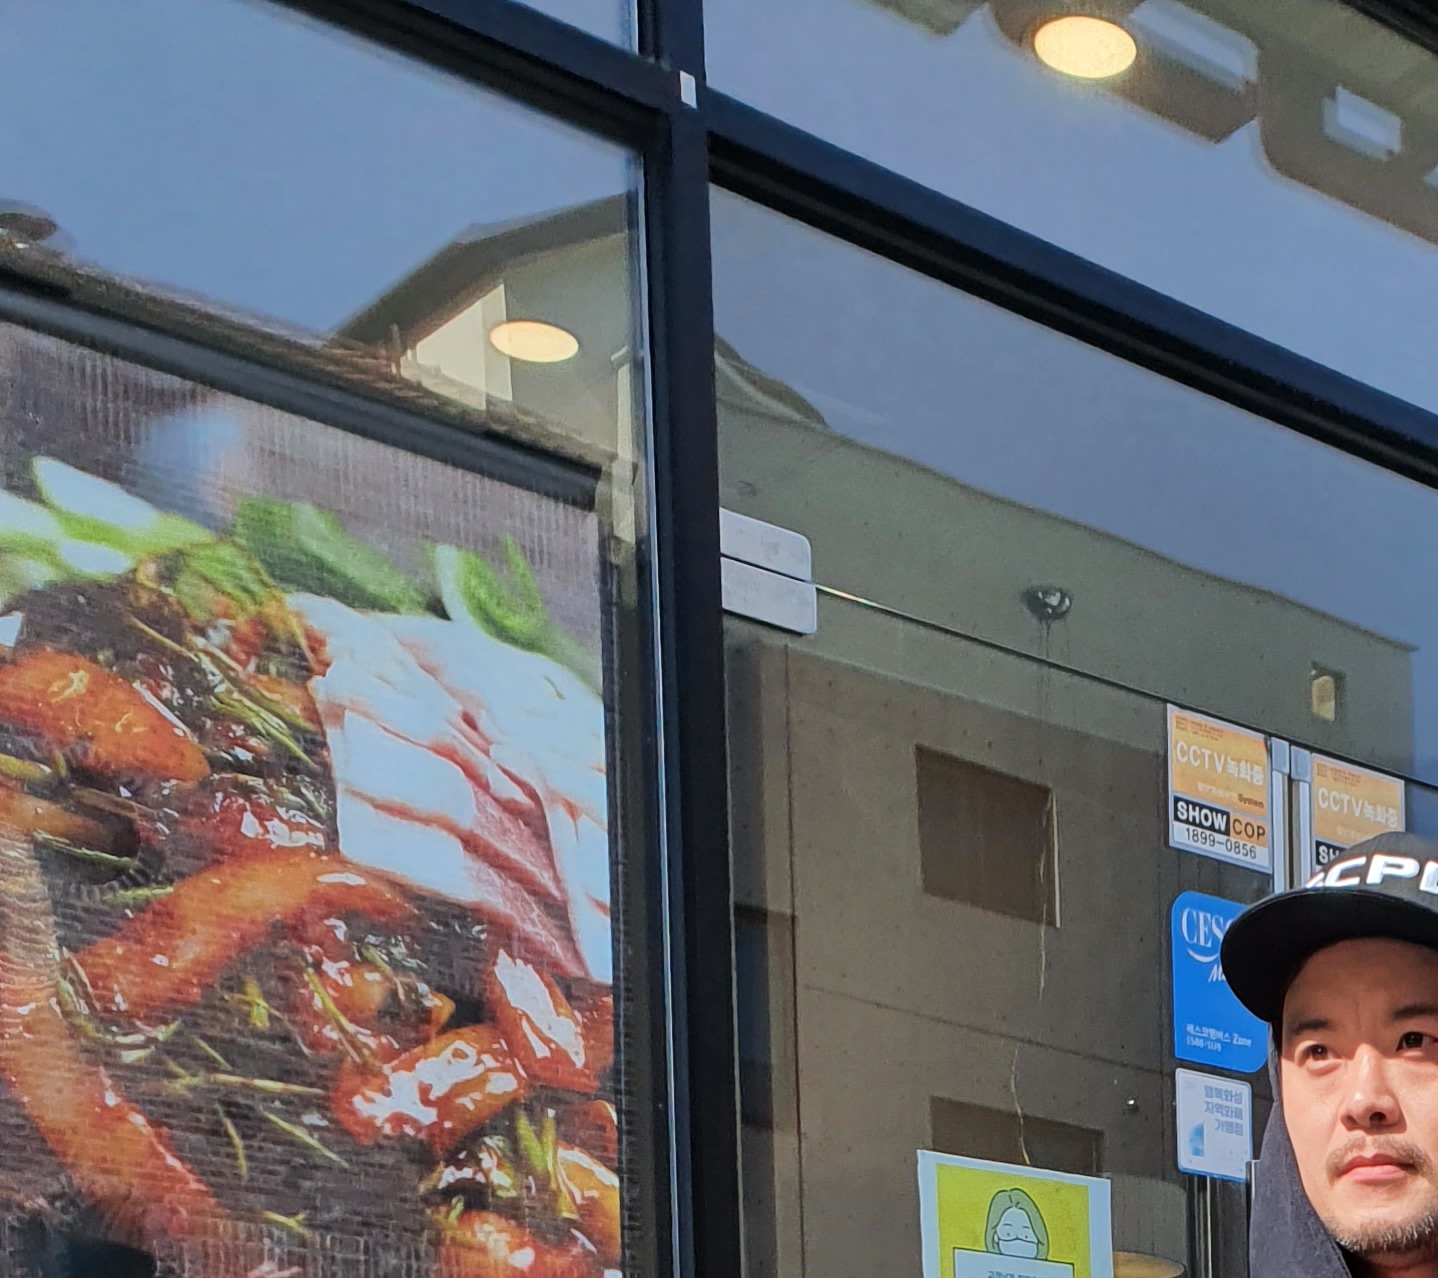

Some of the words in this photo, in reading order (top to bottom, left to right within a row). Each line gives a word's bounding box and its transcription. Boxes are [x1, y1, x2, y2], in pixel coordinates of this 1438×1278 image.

[1176, 801, 1228, 832] SHOW
[1232, 818, 1266, 841] COP
[1185, 827, 1258, 860] 1899-0856
[1181, 907, 1235, 949] CES
